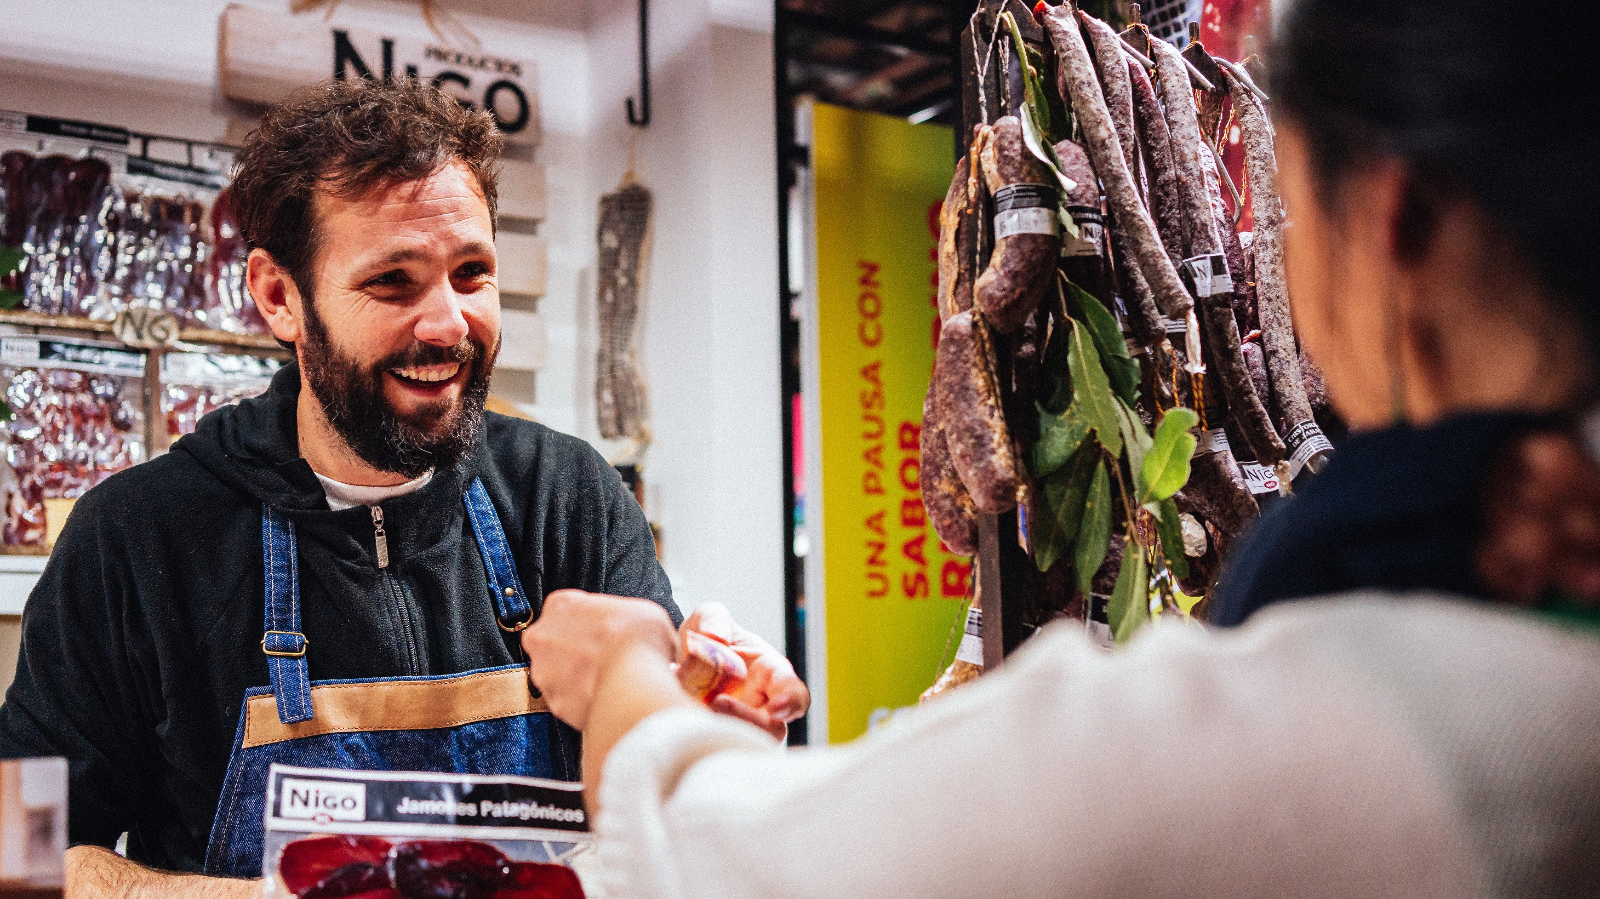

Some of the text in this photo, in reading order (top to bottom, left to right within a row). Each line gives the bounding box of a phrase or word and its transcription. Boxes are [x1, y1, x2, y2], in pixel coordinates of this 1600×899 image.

[120, 311, 170, 343] NG
[857, 260, 890, 598] UNA PAUSA CON
[898, 421, 930, 599] SABOR
[480, 799, 585, 824] Patagónicos
